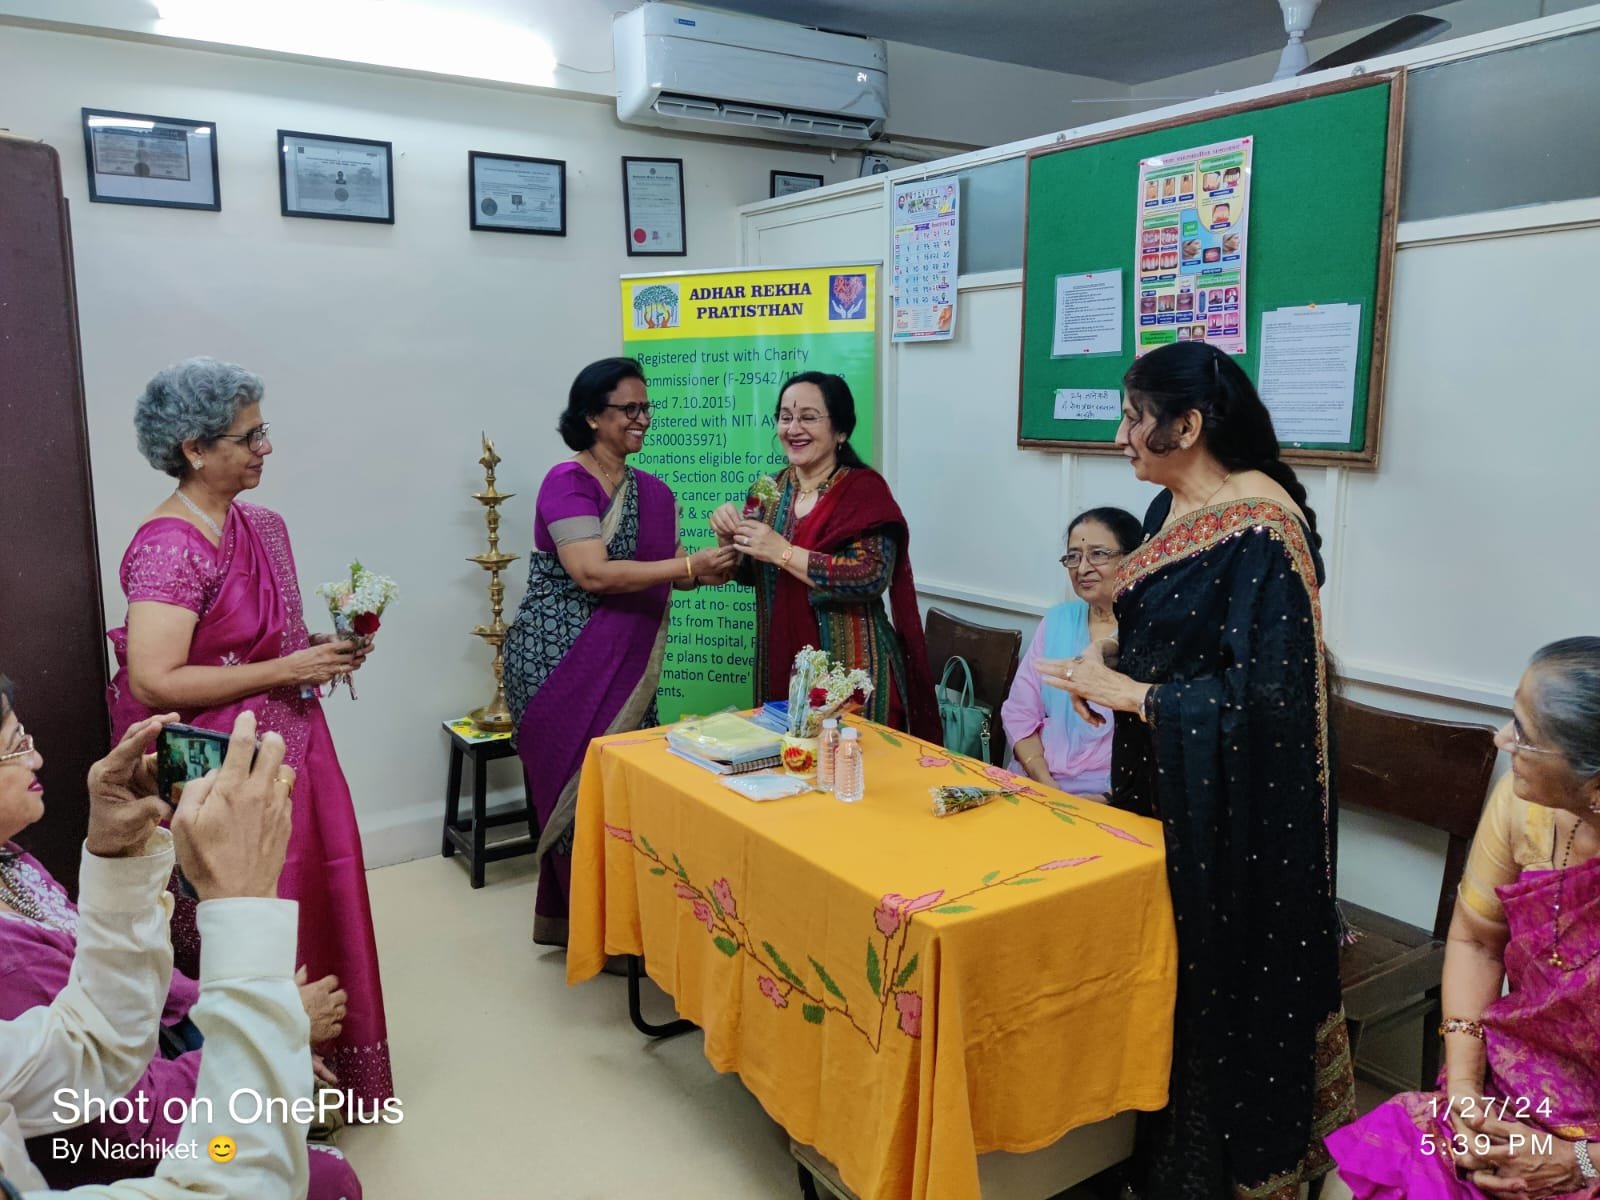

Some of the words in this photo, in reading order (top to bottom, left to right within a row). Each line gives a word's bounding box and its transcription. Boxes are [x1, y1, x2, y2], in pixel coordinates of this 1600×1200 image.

[689, 286, 746, 300] ADHAR
[751, 282, 812, 298] REKHA
[696, 303, 804, 319] PRATISTHAN
[637, 351, 697, 367] Registered
[702, 351, 730, 362] trust
[733, 349, 760, 362] with
[764, 347, 809, 363] Charity
[645, 373, 720, 387] ommissioner
[671, 396, 736, 411] 7.10.2015)
[652, 415, 697, 431] gistered
[702, 415, 727, 428] with
[732, 414, 757, 428] NITI
[639, 452, 696, 465] Donations
[699, 451, 742, 467] eligible
[745, 451, 765, 465] for
[672, 470, 717, 483] Section
[720, 470, 744, 483] 80G
[682, 491, 721, 502] cancer
[688, 506, 698, 519] &
[695, 598, 706, 610] at
[710, 601, 729, 611] no-
[686, 614, 714, 628] from
[716, 616, 755, 630] Thane
[666, 632, 692, 645] orial
[695, 633, 747, 650] Hospital,
[677, 650, 708, 665] plans
[711, 652, 724, 665] to
[663, 669, 704, 681] mation
[657, 686, 685, 698] ents.
